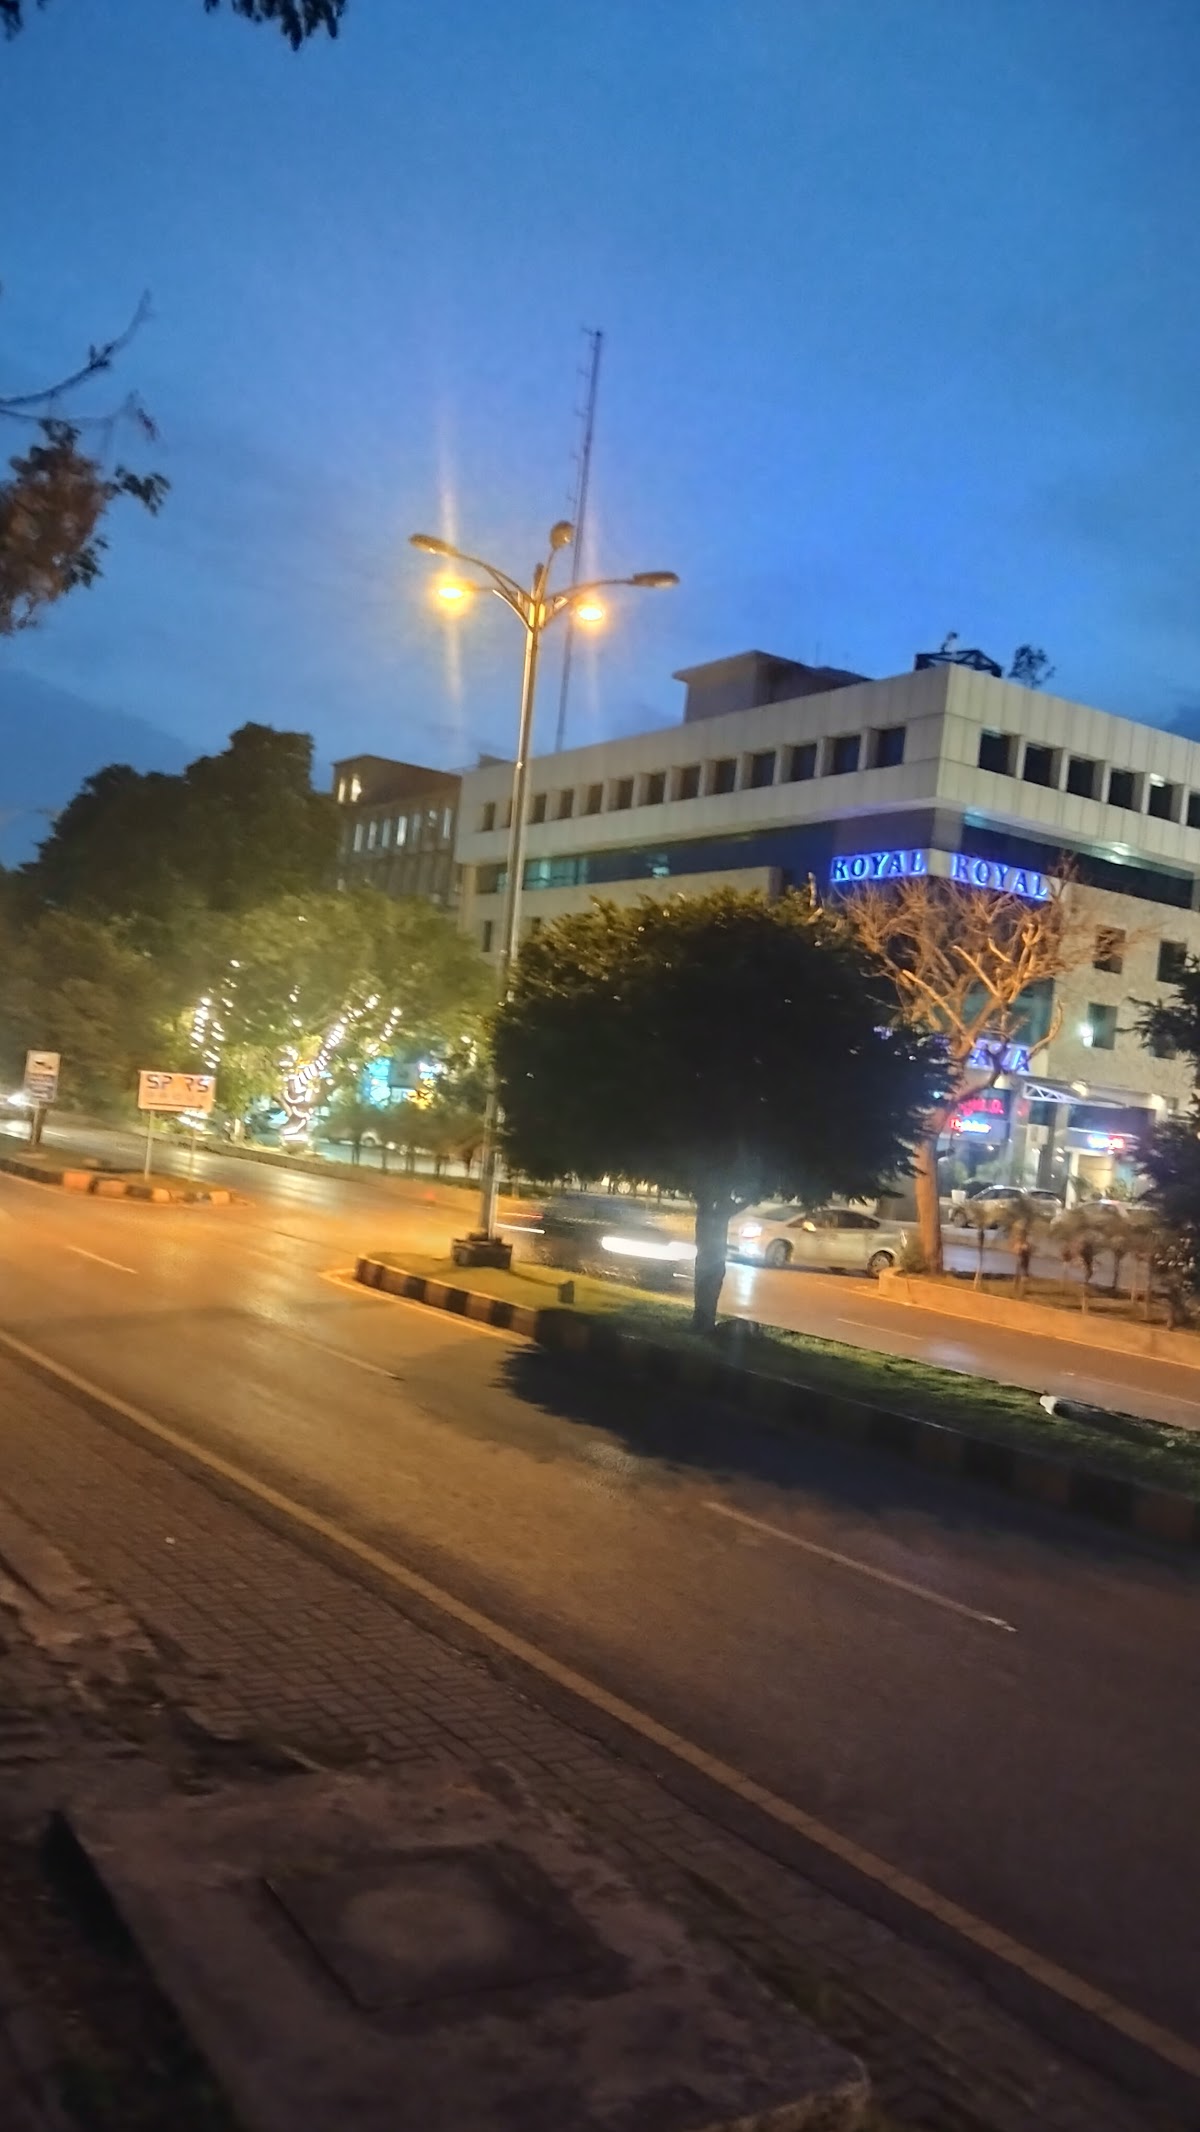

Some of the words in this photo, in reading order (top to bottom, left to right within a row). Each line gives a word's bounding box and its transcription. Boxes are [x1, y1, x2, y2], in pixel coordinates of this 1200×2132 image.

[832, 851, 926, 881] ROYAL
[952, 853, 1049, 899] ROYAL
[146, 1073, 210, 1093] SPRS
